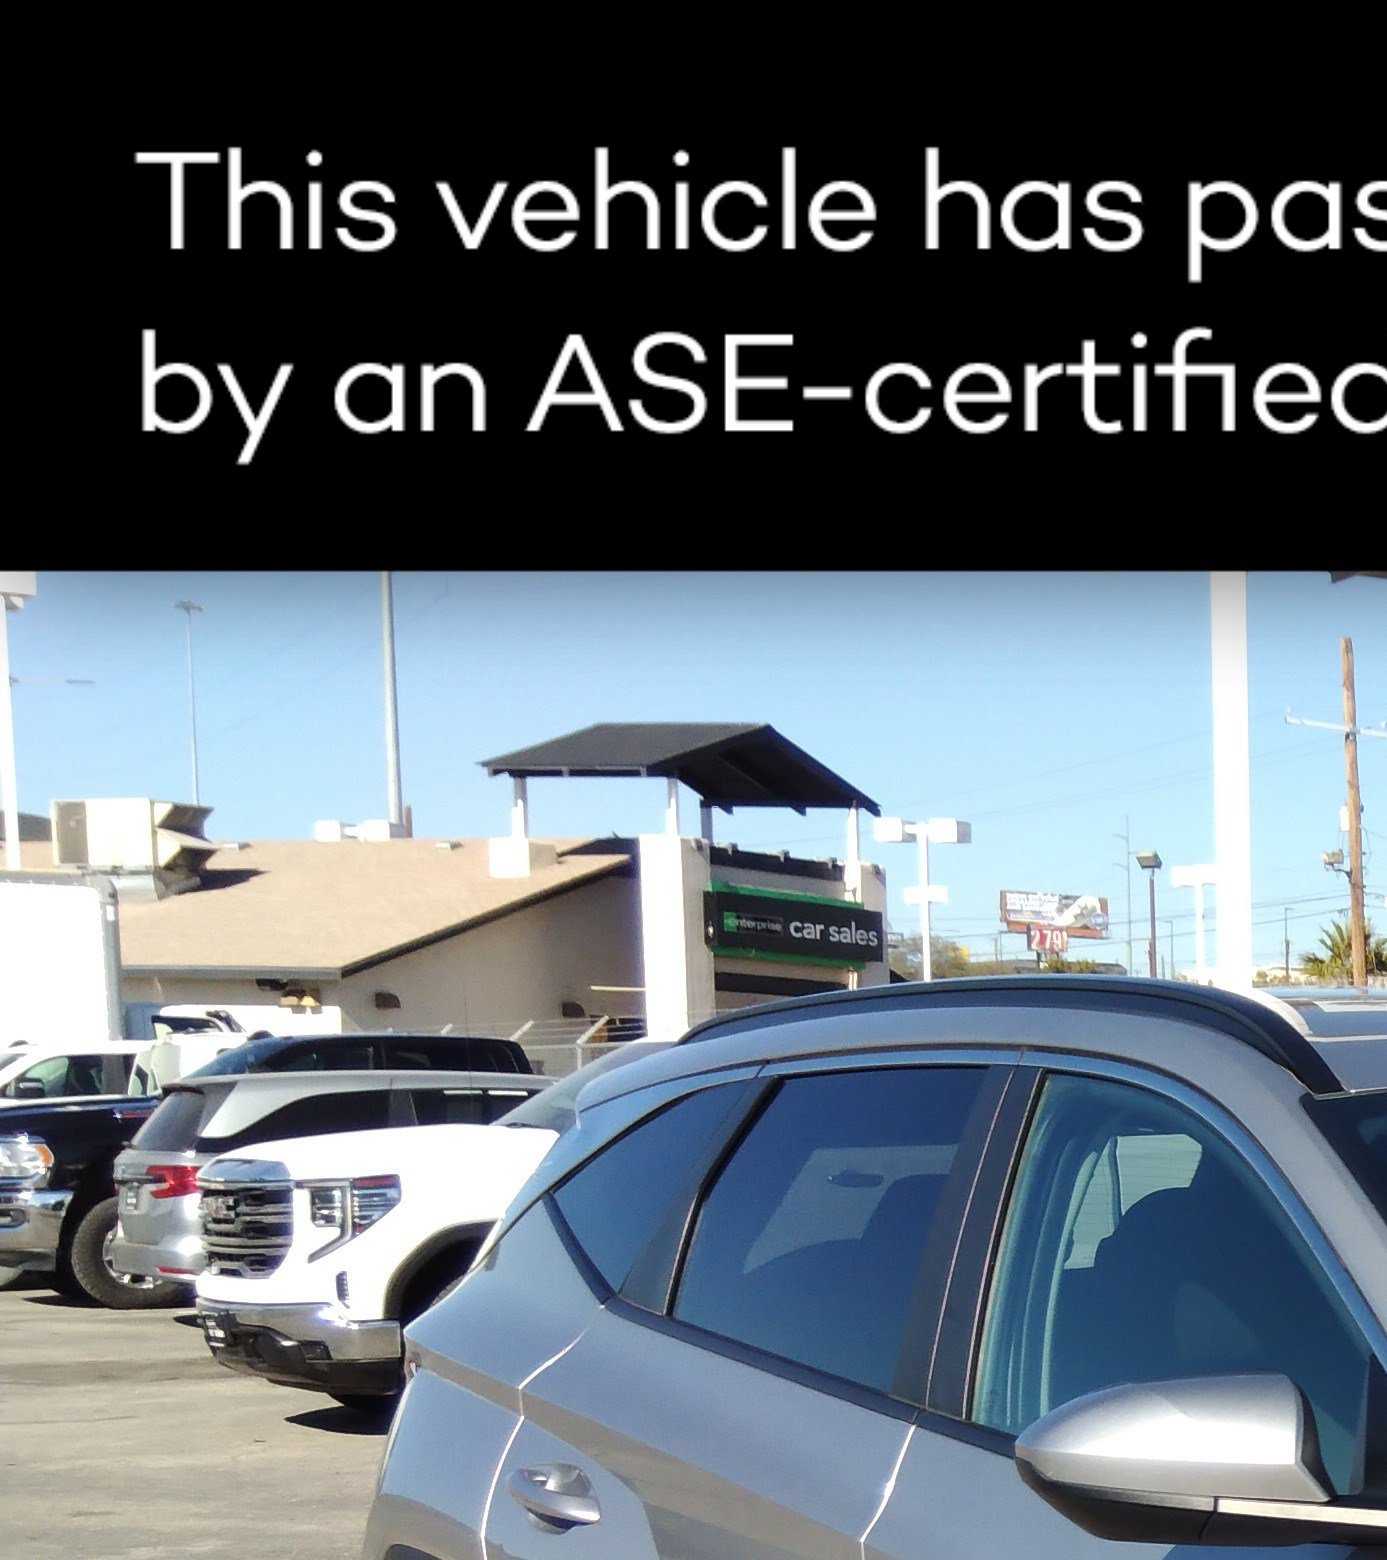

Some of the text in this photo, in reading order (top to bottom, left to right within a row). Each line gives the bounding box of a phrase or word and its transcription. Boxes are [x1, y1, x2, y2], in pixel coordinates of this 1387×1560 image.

[726, 917, 878, 946] enterprise car sales
